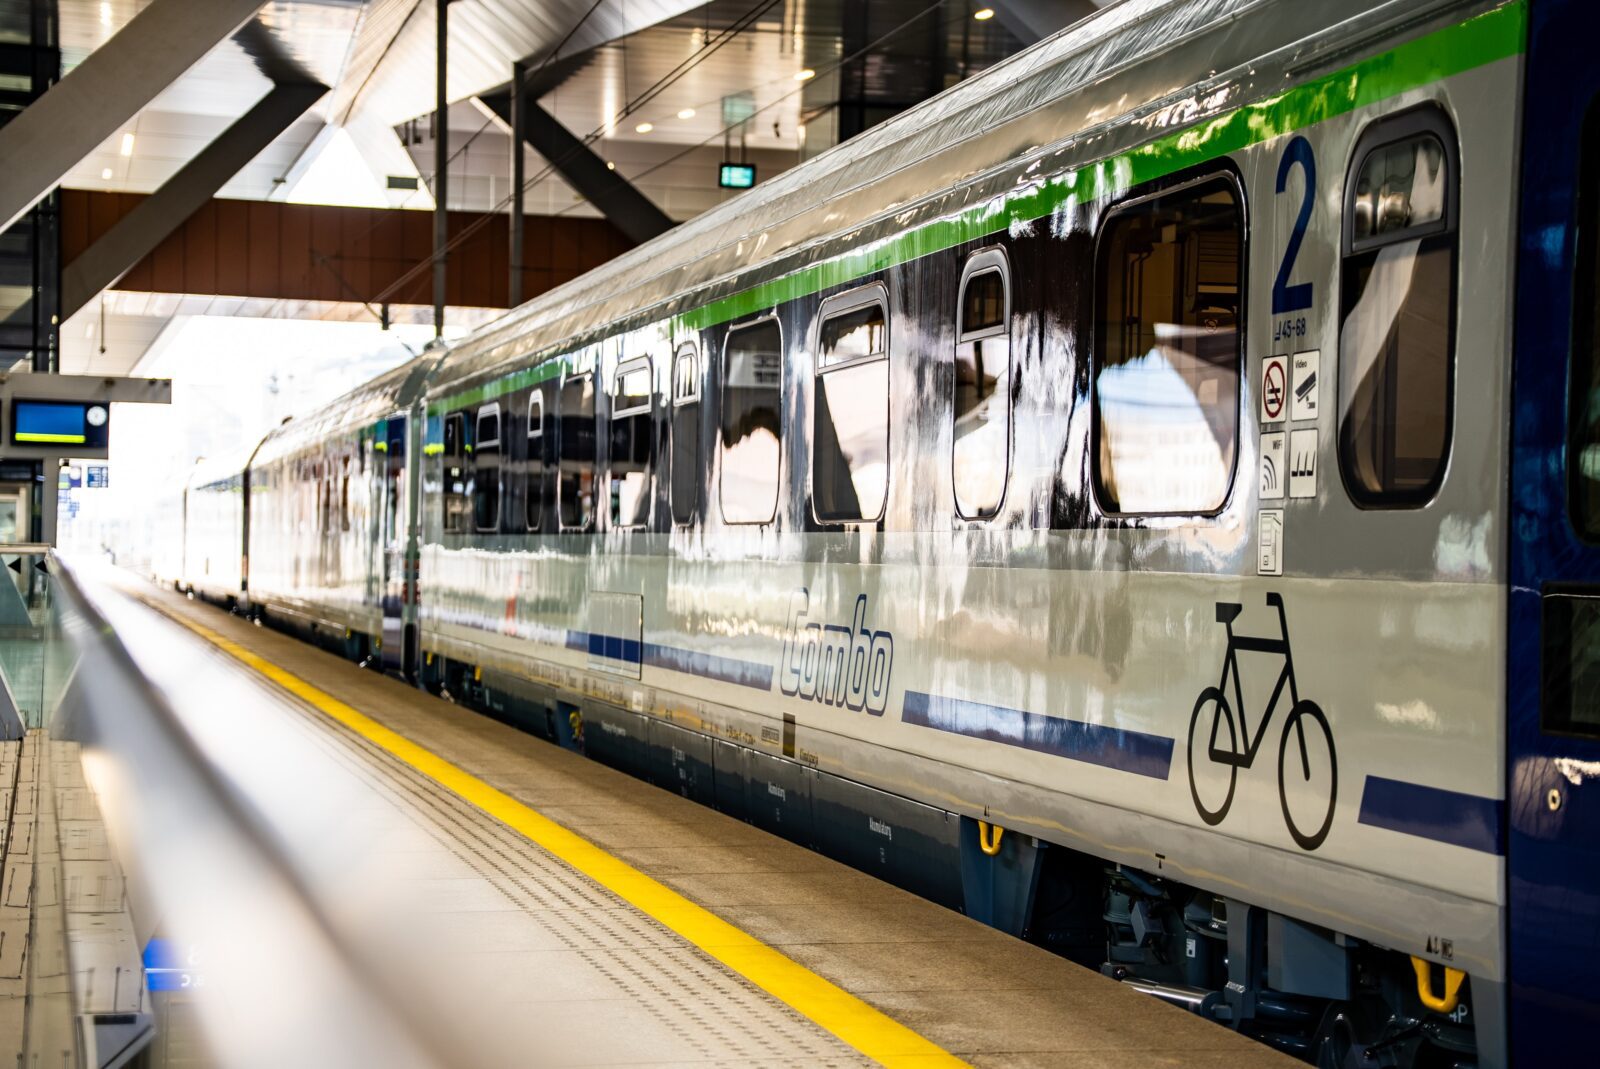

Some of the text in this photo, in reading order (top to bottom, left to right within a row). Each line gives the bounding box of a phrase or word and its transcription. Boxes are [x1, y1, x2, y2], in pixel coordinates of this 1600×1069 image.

[1272, 135, 1317, 315] 2
[1281, 317, 1306, 338] 45-68
[1295, 360, 1308, 368] Video
[780, 586, 894, 718] Combo
